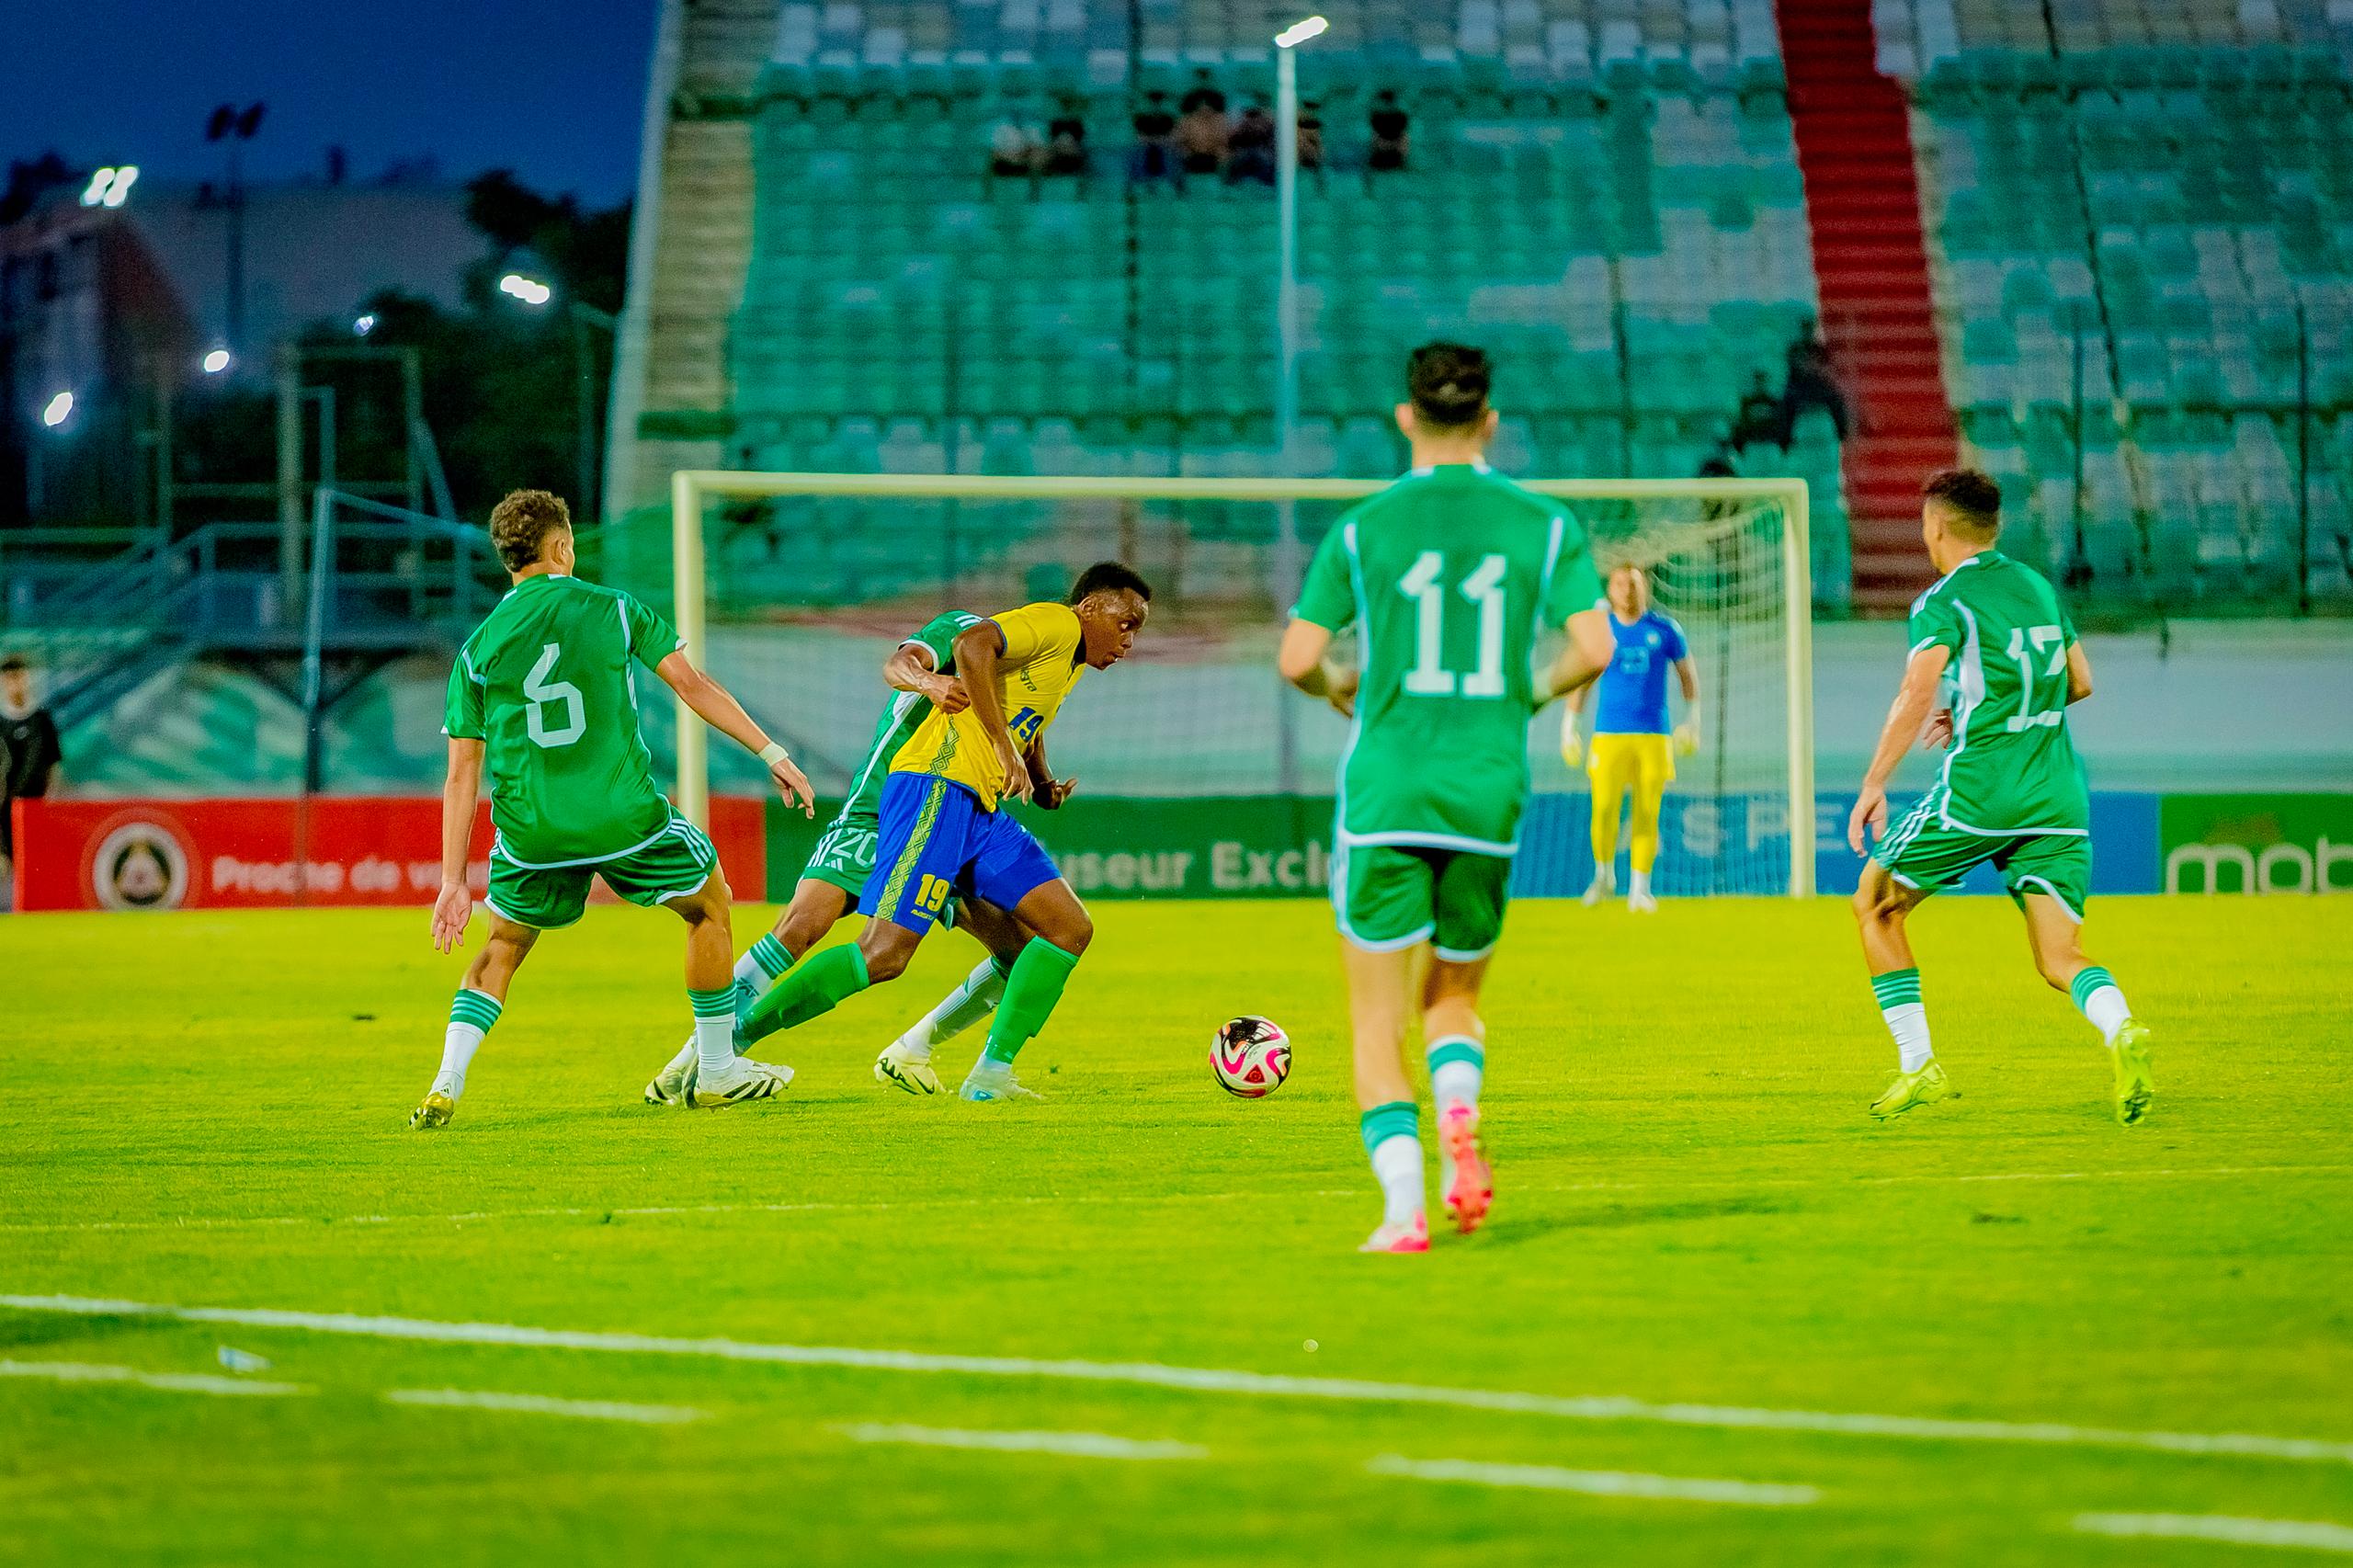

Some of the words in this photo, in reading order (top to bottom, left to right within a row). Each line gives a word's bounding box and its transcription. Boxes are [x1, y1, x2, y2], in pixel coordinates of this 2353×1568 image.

[1397, 550, 1507, 699] 11
[522, 642, 587, 748] 6
[1008, 706, 1046, 743] 19
[830, 827, 880, 868] 20
[1211, 840, 1331, 890] Excl
[349, 855, 401, 892] de
[914, 873, 950, 913] 19
